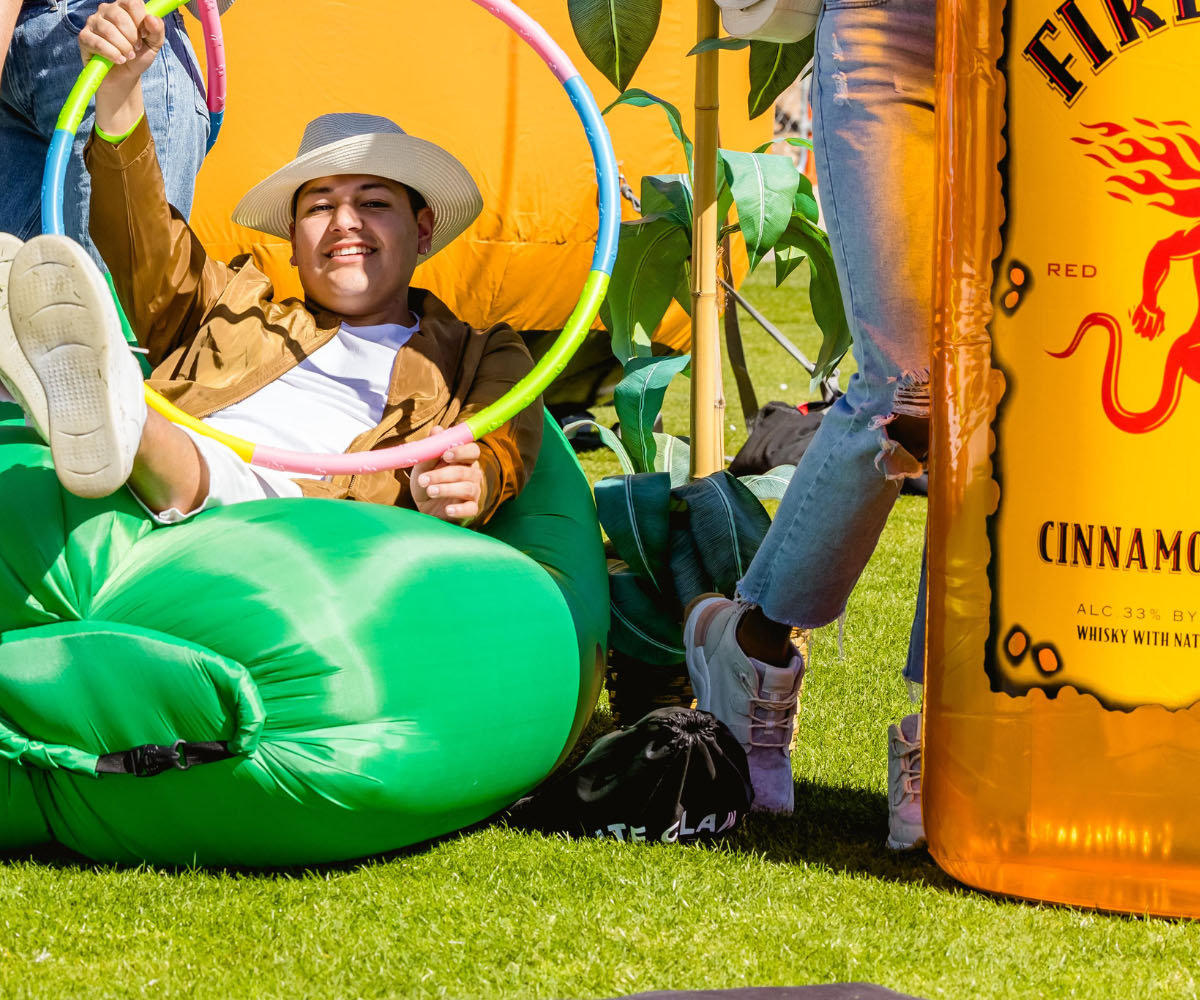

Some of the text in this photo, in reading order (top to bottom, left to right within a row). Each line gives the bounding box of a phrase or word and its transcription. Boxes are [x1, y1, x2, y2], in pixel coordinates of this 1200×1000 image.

[1046, 261, 1098, 279] RED
[1036, 519, 1200, 575] CINNAMO
[1173, 610, 1197, 622] BY
[1076, 624, 1129, 645] WHISKY
[1133, 629, 1169, 647] WITH
